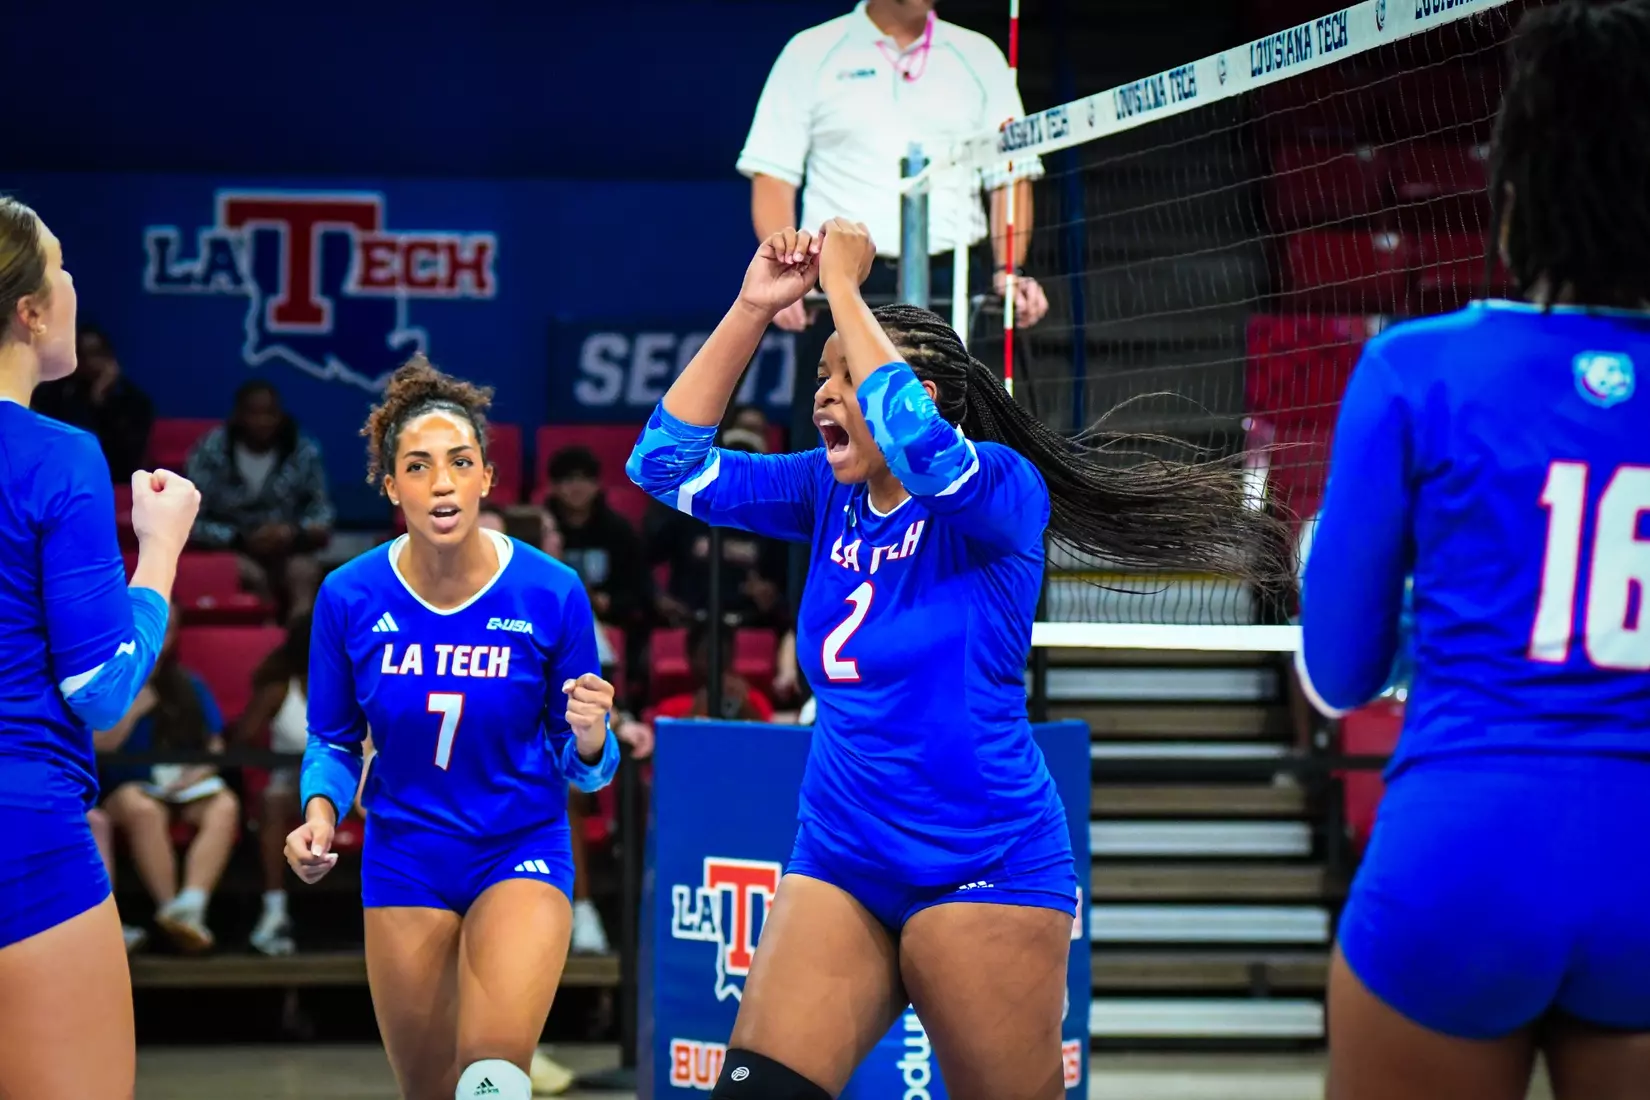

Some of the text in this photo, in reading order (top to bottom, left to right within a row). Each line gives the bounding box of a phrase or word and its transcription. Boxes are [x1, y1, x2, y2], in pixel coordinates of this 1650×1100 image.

[1250, 10, 1348, 77] LOUISIANA TECH
[1168, 63, 1197, 104] TECH
[145, 226, 252, 294] LA
[1527, 460, 1650, 671] 16
[381, 643, 511, 678] LA TECH
[821, 579, 876, 682] 2
[427, 691, 465, 771] 7
[672, 885, 723, 942] LA
